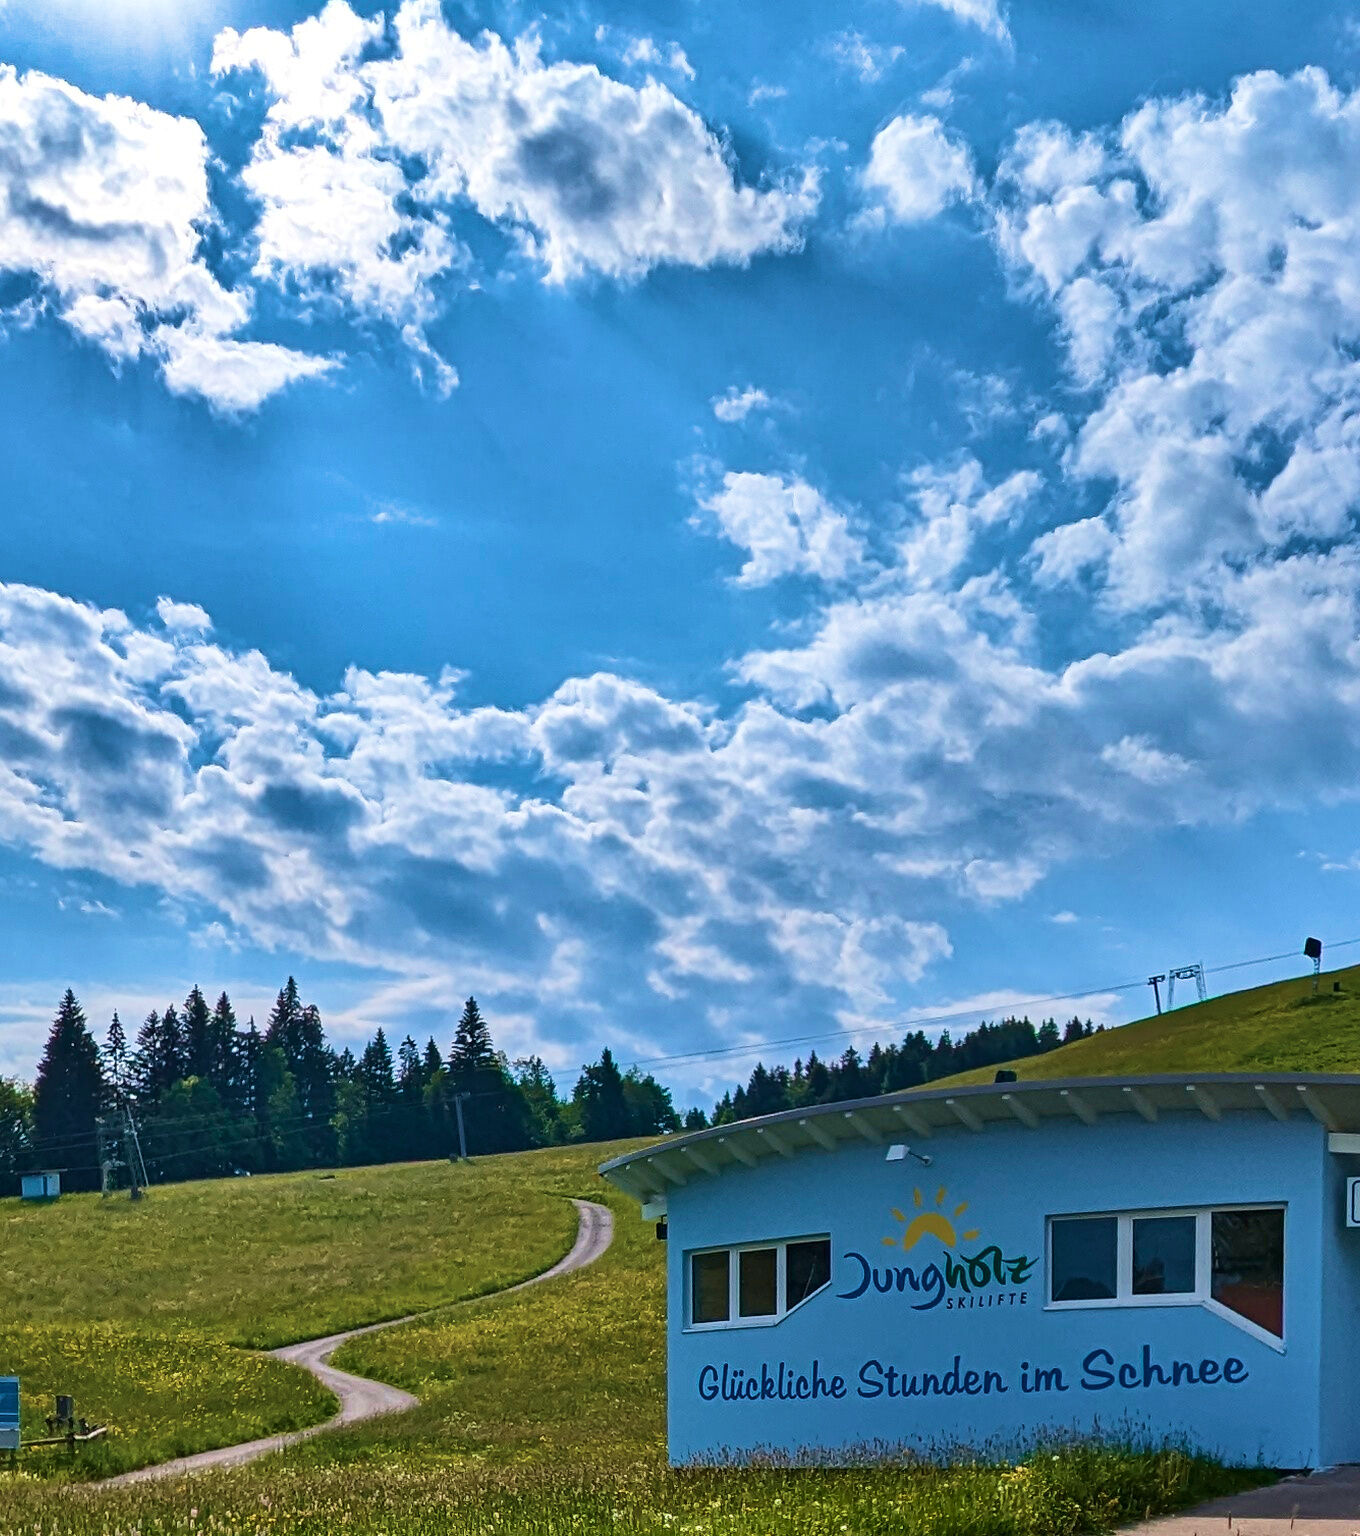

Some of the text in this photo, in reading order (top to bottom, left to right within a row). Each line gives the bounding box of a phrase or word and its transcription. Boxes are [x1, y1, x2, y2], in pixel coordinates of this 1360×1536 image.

[836, 1245, 1040, 1311] Jungholz
[946, 1292, 1028, 1310] SKILIFTE
[698, 1344, 1249, 1401] Glückliche Stunden im Schnee
